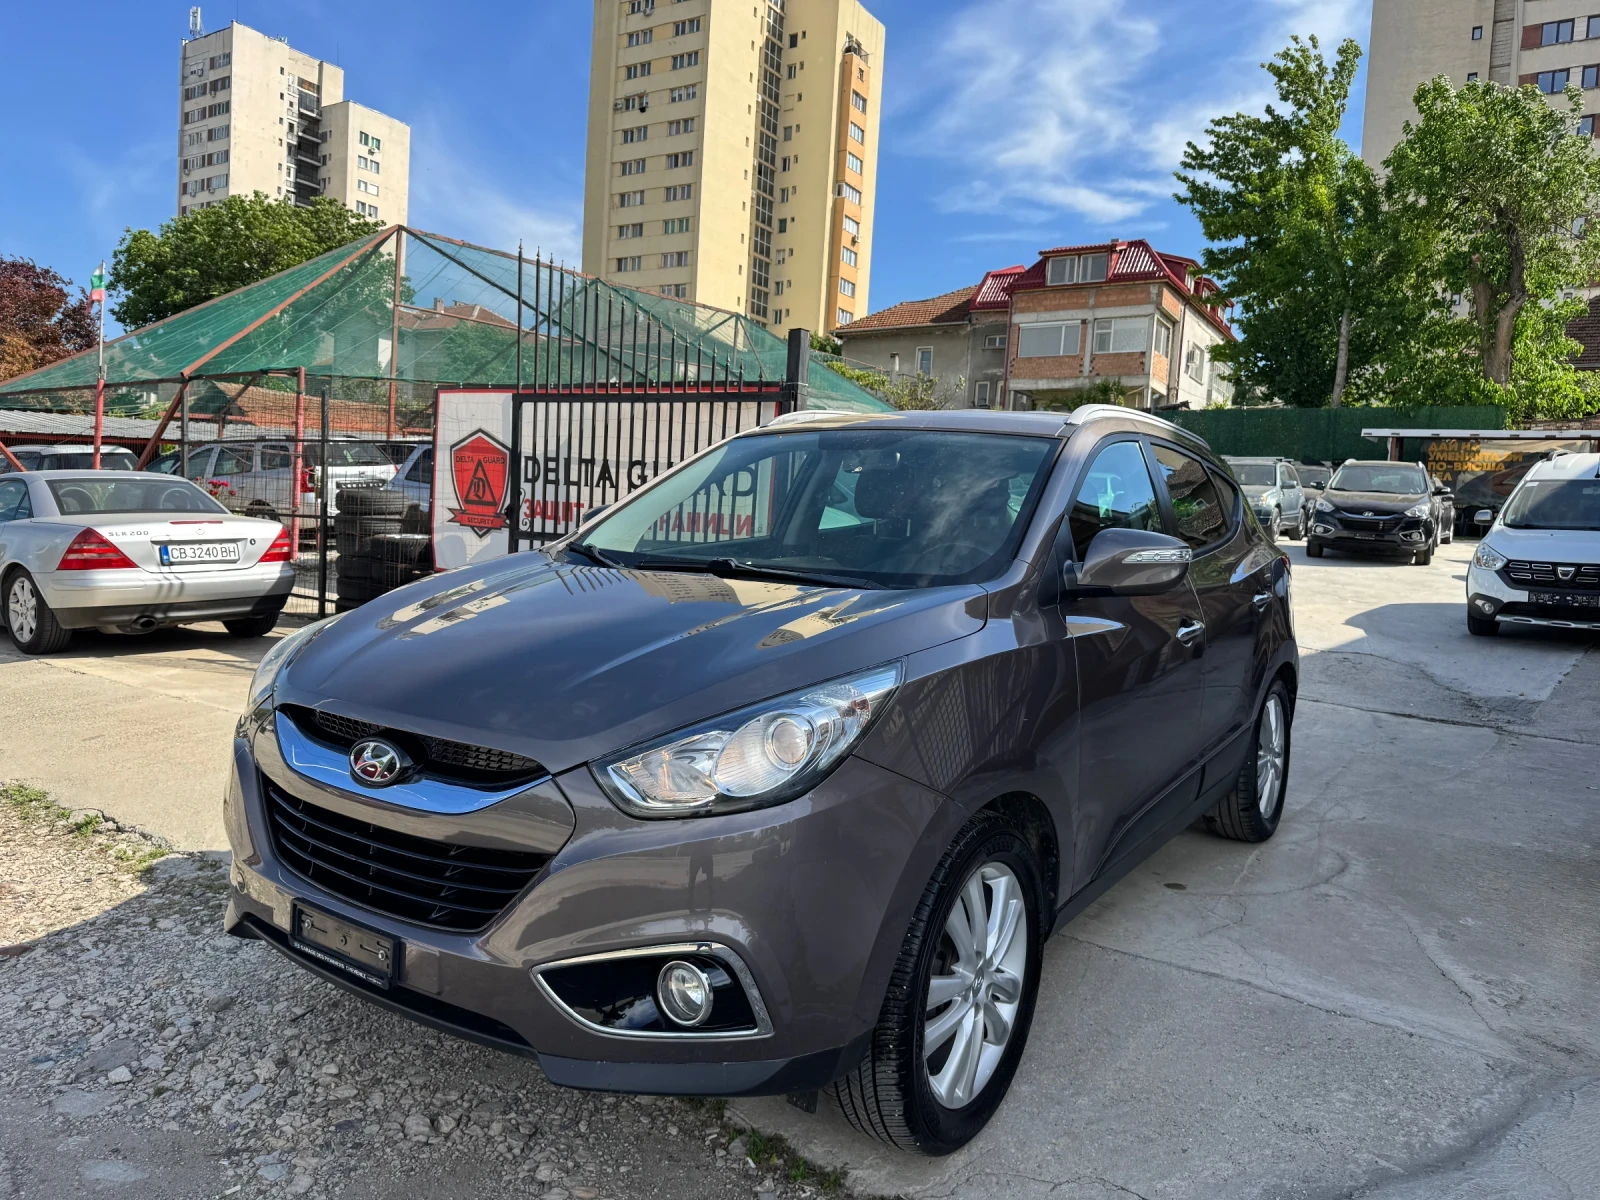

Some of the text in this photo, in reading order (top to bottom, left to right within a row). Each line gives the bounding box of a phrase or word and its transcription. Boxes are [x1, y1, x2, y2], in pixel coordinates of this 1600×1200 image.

[456, 456, 506, 465] DELTA GUARD
[1427, 461, 1505, 471] ПО-ВИСША
[523, 456, 616, 488] DELTA
[467, 516, 494, 525] SECURITY
[524, 498, 753, 536] ЗАЩИТ РАНИЦИ
[170, 547, 186, 560] CB
[189, 546, 219, 559] 3240
[220, 546, 237, 558] BH
